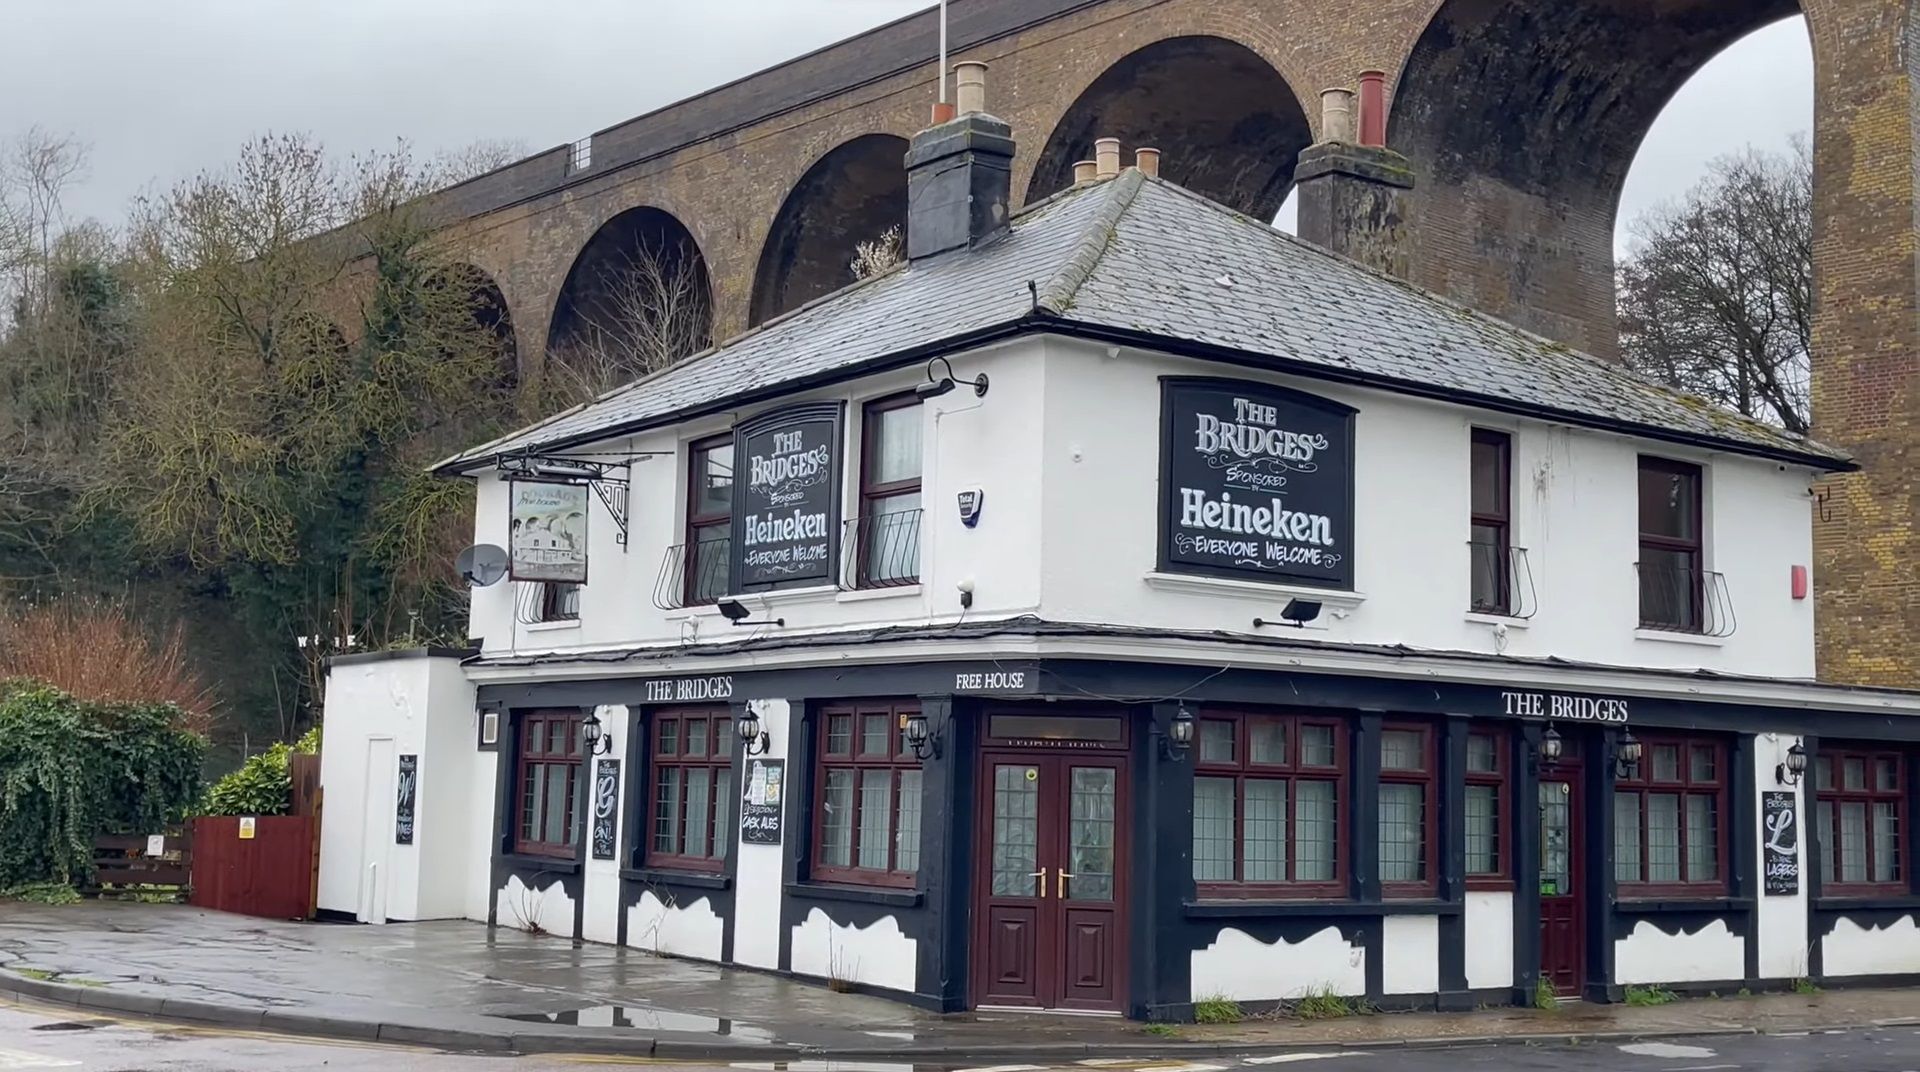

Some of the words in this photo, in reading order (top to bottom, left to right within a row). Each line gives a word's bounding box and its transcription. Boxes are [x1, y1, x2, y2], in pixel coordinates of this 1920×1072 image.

[1233, 397, 1277, 426] THE
[774, 430, 803, 456] THE
[1195, 413, 1328, 462] BRIDGES
[750, 445, 829, 487] BRIDGES
[1226, 465, 1287, 487] SPONSORED
[745, 509, 827, 546] Heineken
[1180, 488, 1334, 546] Heineken
[749, 549, 791, 566] EVERYONE
[793, 543, 828, 562] WELCOME
[1195, 536, 1259, 558] EVERYONE
[1266, 541, 1322, 565] WELCOME
[645, 680, 673, 701] THE
[676, 675, 733, 700] BRIDGES
[956, 673, 983, 689] FREE
[984, 672, 1025, 689] HOUSE
[1501, 691, 1545, 716] THE
[1550, 695, 1628, 722] BRIDGES
[1766, 862, 1798, 876] LAGERS
